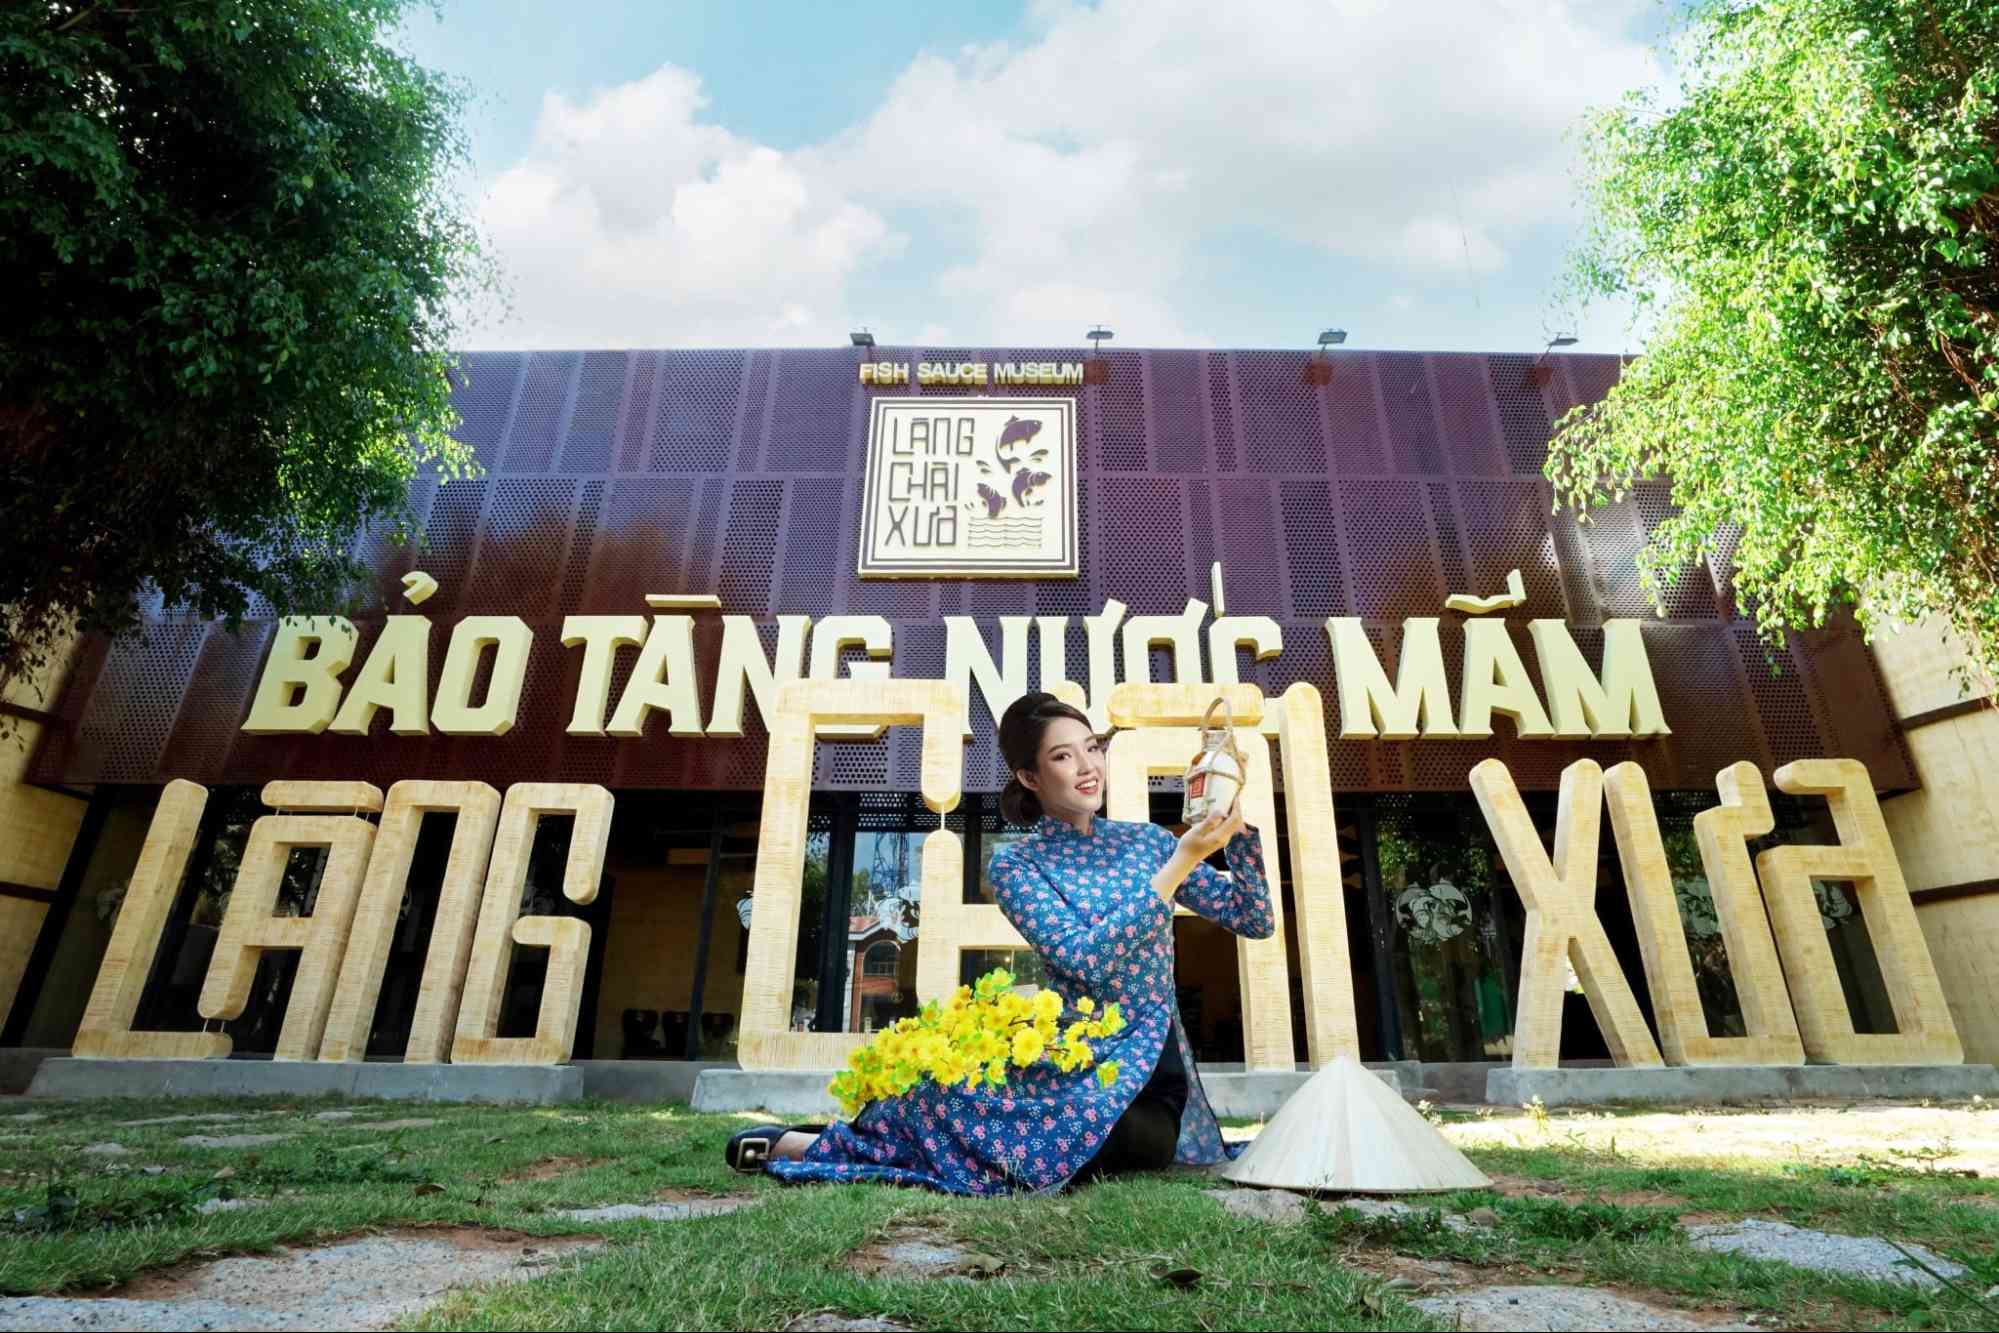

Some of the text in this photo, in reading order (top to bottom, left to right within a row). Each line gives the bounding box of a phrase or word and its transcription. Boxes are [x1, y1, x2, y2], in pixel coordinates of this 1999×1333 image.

[859, 362, 1084, 385] FISH SAUCE MUSEUM
[241, 570, 534, 737] BẢO
[1325, 568, 1672, 741] MẮM
